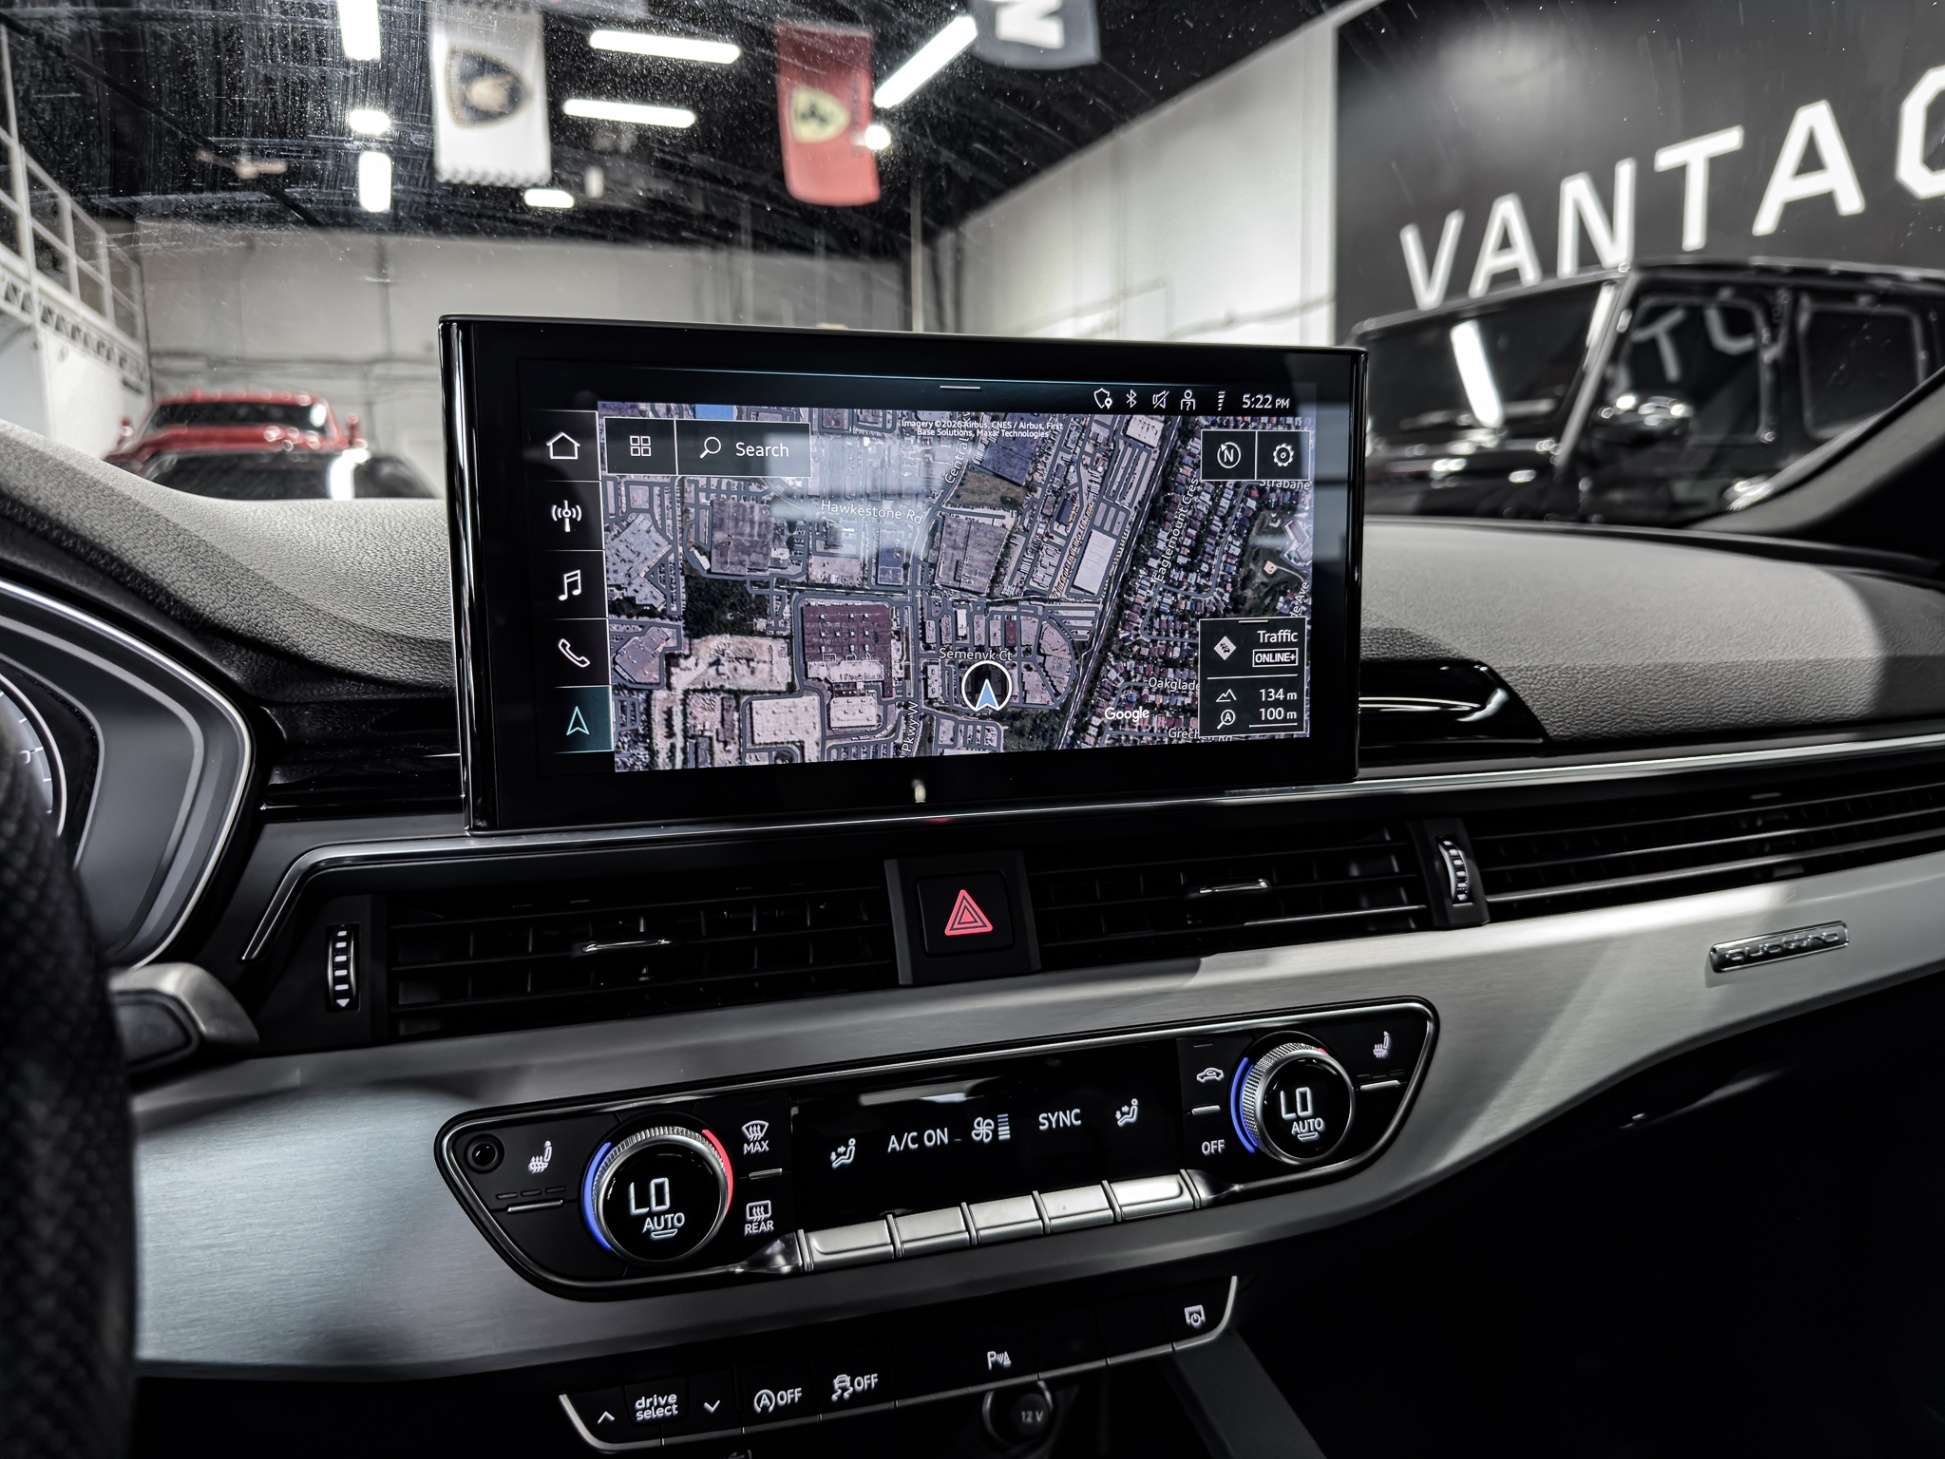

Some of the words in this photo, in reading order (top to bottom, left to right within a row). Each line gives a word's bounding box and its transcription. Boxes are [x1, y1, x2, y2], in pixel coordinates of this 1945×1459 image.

[1242, 394, 1272, 409] 5:22
[1275, 398, 1290, 409] PM
[901, 420, 934, 429] Imagery
[991, 421, 1012, 429] CNES
[1019, 422, 1045, 431] Airbus,
[917, 428, 935, 436] Base
[1001, 430, 1050, 439] Technologies
[736, 441, 789, 457] Search
[944, 437, 970, 484] Central
[820, 500, 902, 520] Hawkestone
[1154, 506, 1188, 582] Eaglemount
[1257, 629, 1298, 643] Traffic
[999, 650, 1013, 661] Ct
[1255, 652, 1296, 663] ONLINE+
[1259, 688, 1284, 702] 134
[1287, 692, 1298, 701] m
[1104, 705, 1150, 723] Google
[1259, 707, 1284, 721] 100
[1287, 712, 1297, 720] m
[1280, 1087, 1313, 1120] LO
[1038, 1109, 1082, 1130] SYNC
[1291, 1117, 1325, 1135] AUTO
[743, 1140, 769, 1155] MAX
[887, 1131, 918, 1153] A/C
[923, 1127, 949, 1149] ON
[1201, 1139, 1225, 1156] OFF
[628, 1177, 670, 1216] LO
[642, 1212, 685, 1233] AUTO
[744, 1220, 774, 1236] REAR
[853, 1373, 878, 1393] OFF
[634, 1393, 677, 1410] drive
[777, 1388, 802, 1407] OFF
[635, 1404, 679, 1421] select
